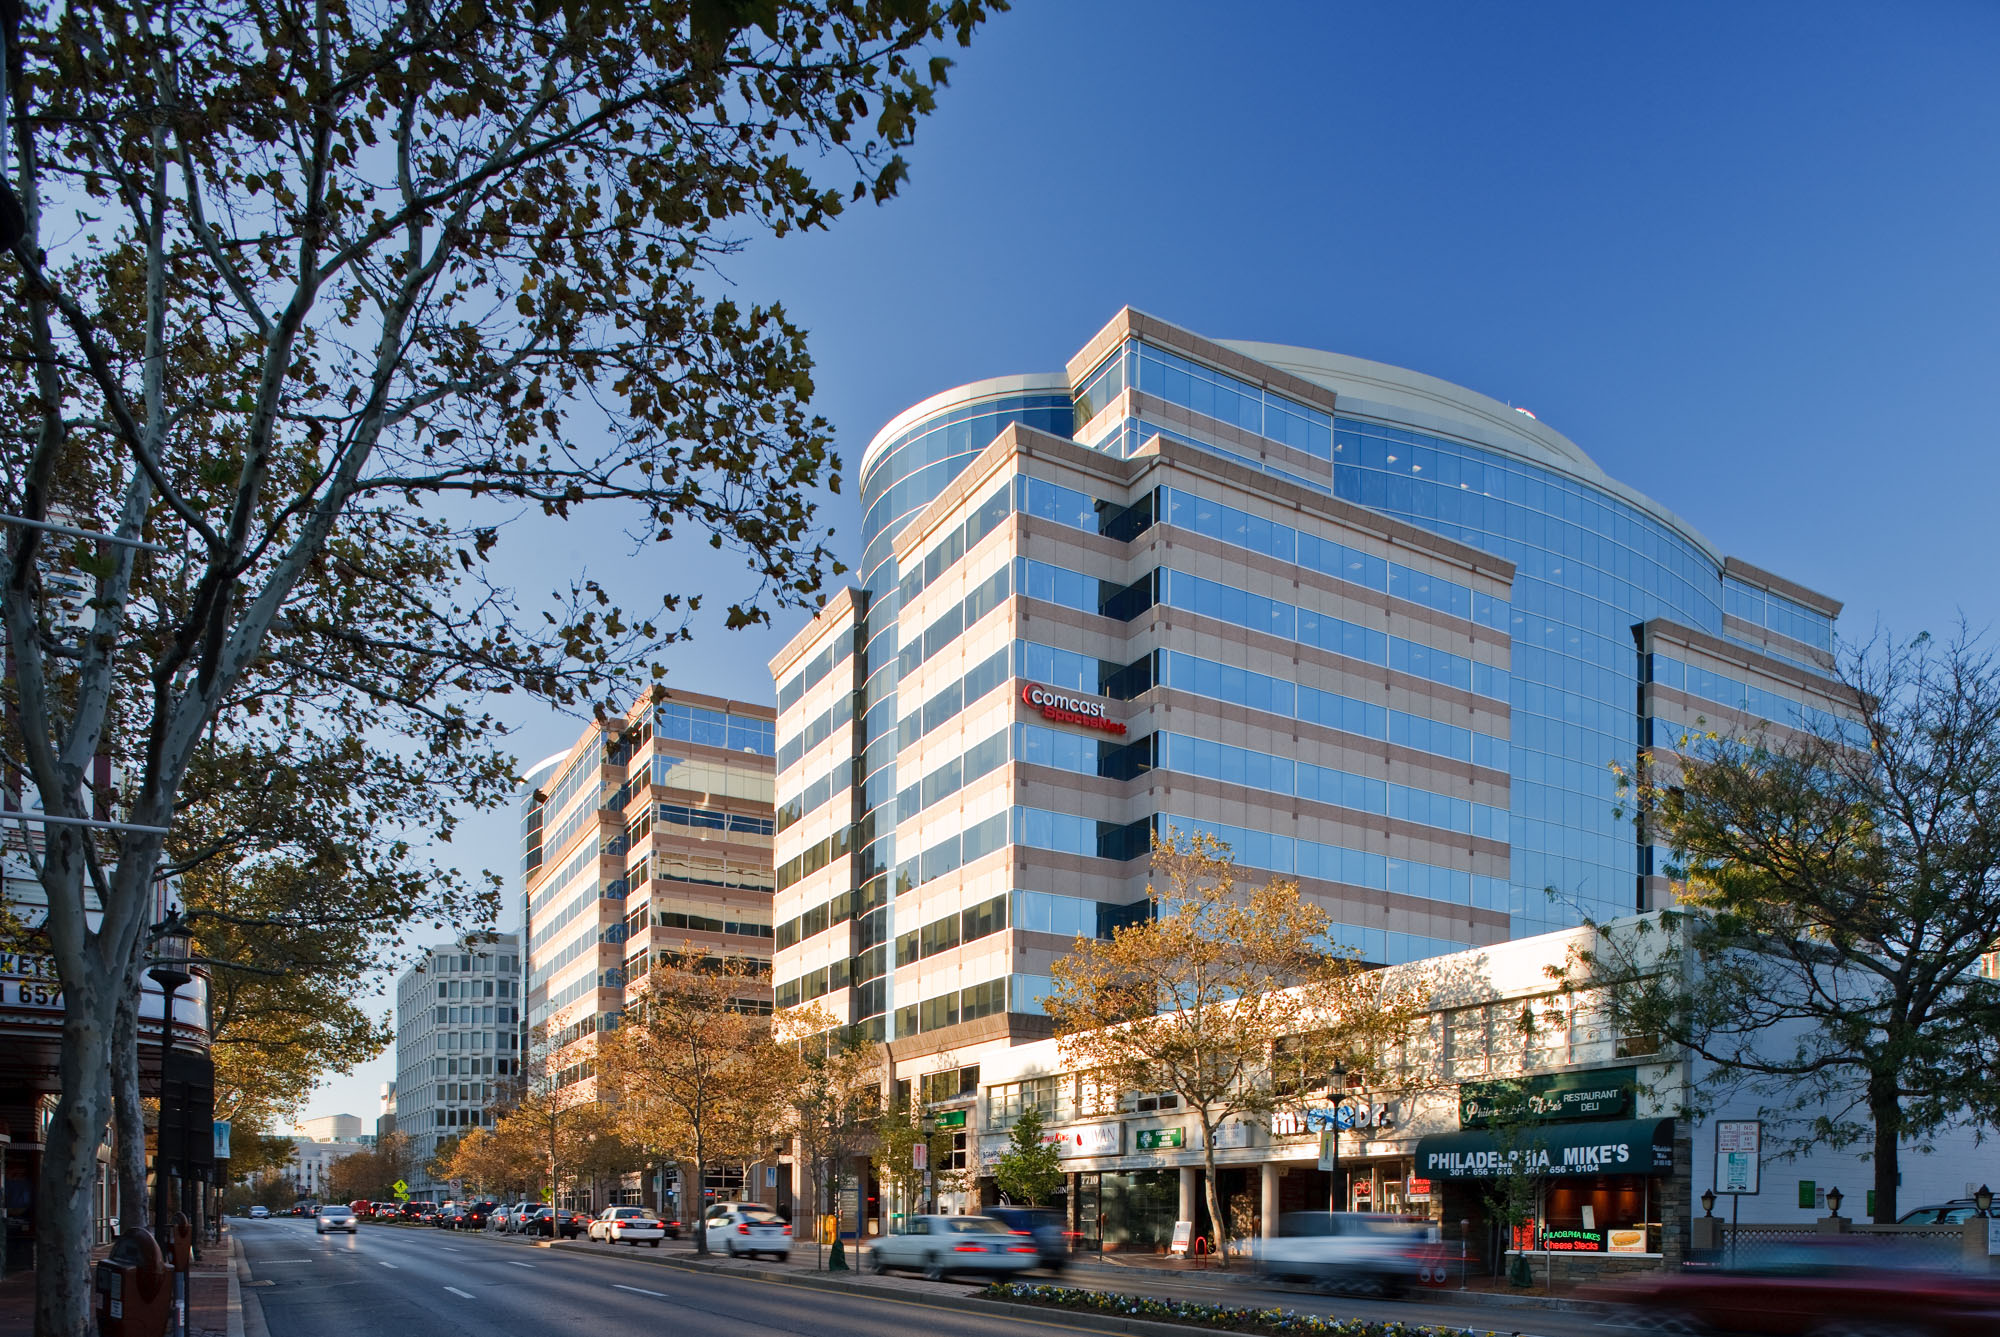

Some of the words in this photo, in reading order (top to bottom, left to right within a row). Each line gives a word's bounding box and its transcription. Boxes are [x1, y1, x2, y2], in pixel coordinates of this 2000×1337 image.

[1563, 1089, 1619, 1102] RESTAURANT
[1580, 1102, 1600, 1112] DELI
[1563, 1144, 1630, 1166] MIKE'S
[1473, 1168, 1488, 1176] 656
[1576, 1164, 1599, 1173] 0104
[1080, 1176, 1098, 1185] 7710
[1543, 1230, 1581, 1240] PILADELPHIA
[1543, 1240, 1573, 1250] Cheese
[1574, 1240, 1599, 1250] Steaks
